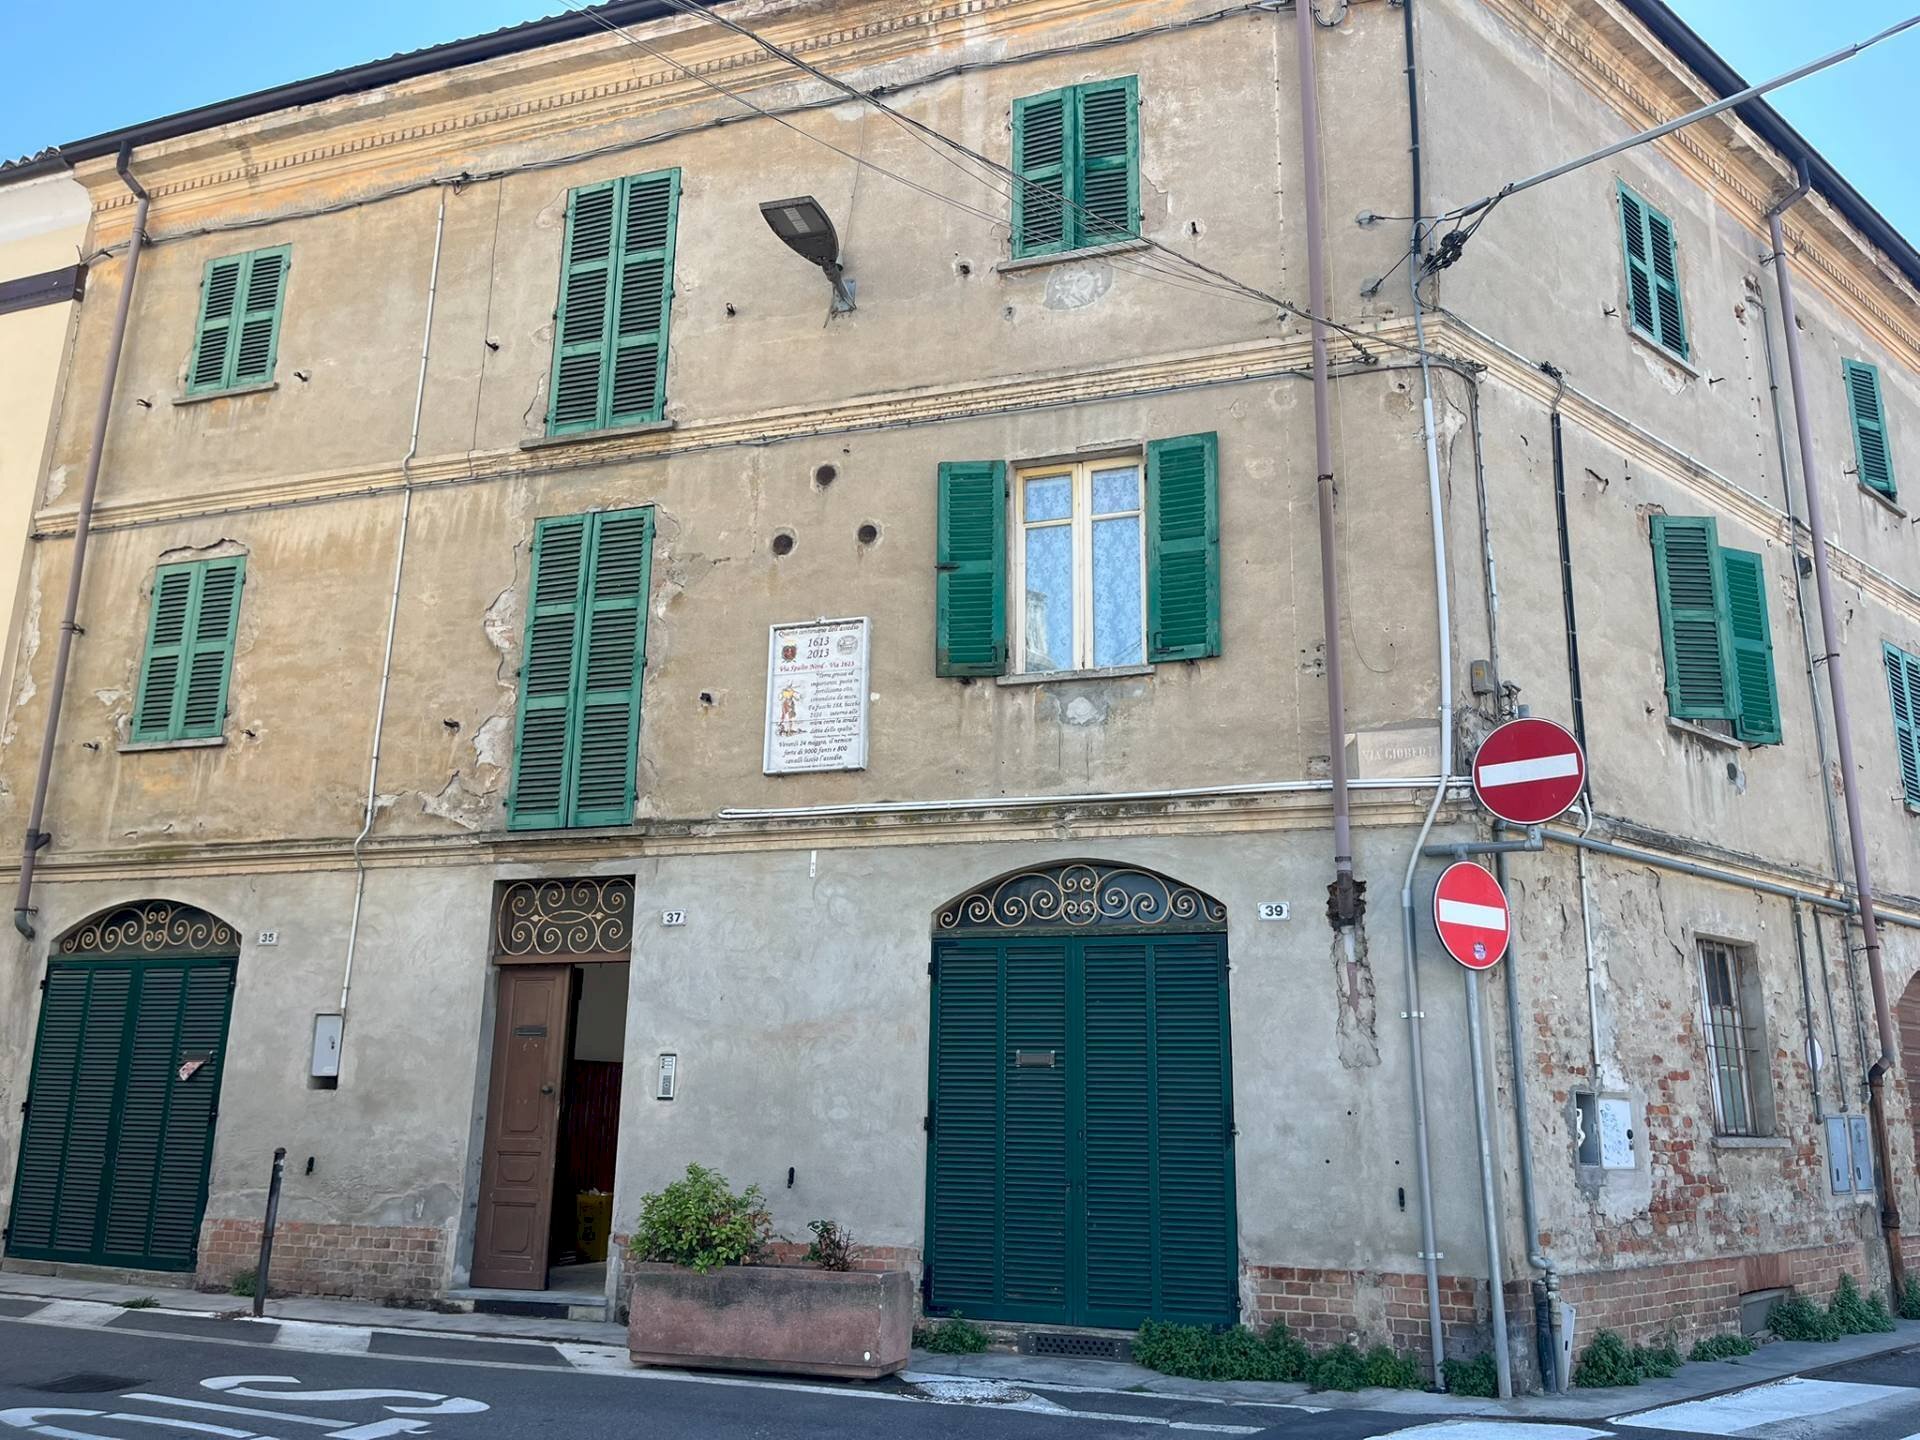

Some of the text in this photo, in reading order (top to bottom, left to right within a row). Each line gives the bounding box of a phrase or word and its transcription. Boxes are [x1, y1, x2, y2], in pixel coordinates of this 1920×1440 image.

[807, 636, 830, 647] 1613
[806, 649, 830, 659] 2013
[1361, 750, 1381, 760] VIA
[1265, 905, 1283, 916] 39
[667, 912, 681, 923] 37
[262, 933, 274, 942] 35
